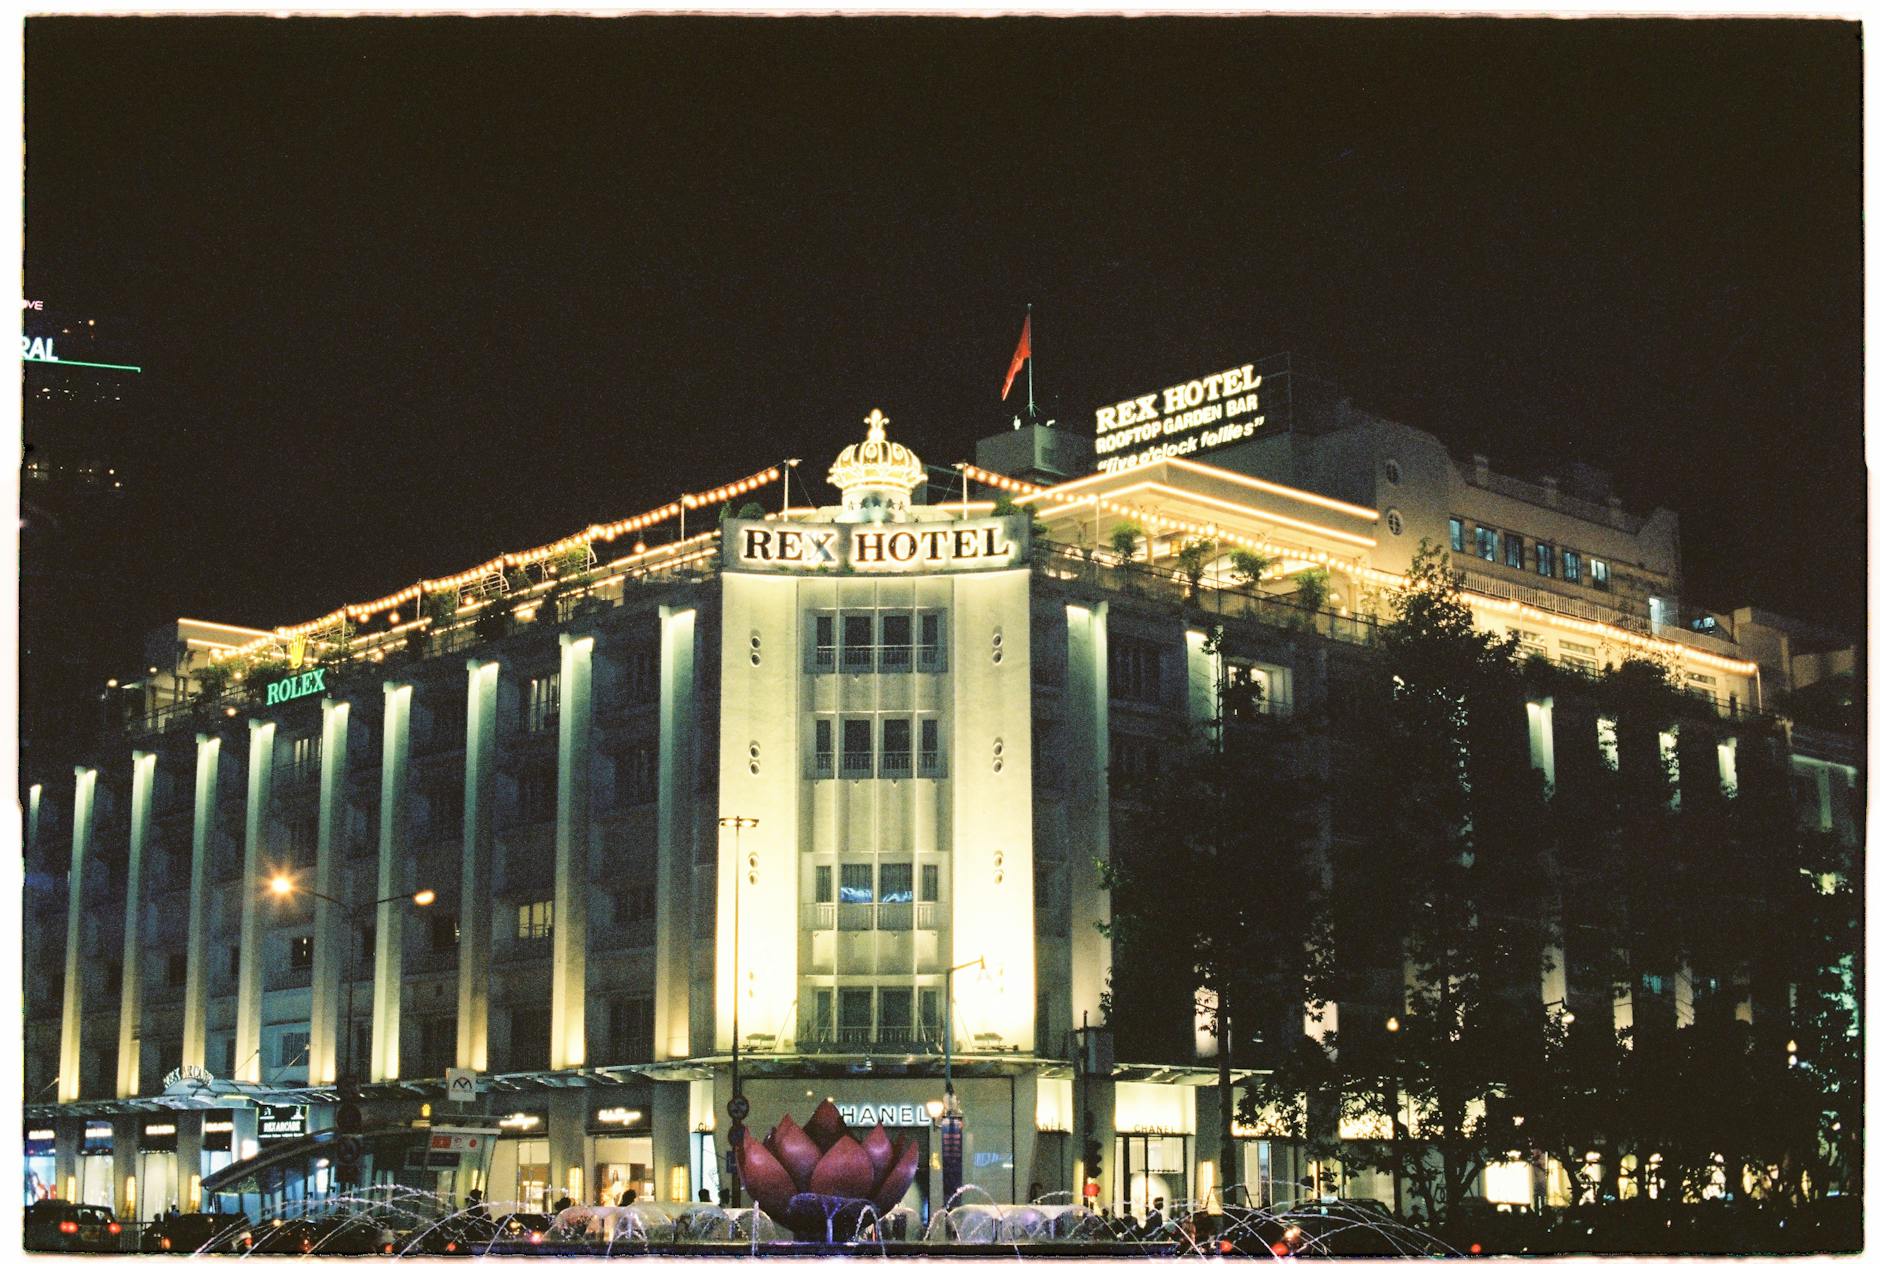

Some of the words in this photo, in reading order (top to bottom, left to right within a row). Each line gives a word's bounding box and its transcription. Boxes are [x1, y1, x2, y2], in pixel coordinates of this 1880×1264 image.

[1096, 394, 1159, 434] REX
[1163, 364, 1263, 415] HOTEL
[1095, 420, 1163, 454] ROOFTOP
[1163, 404, 1222, 435] GARDEN
[1226, 394, 1259, 418] BAR
[743, 529, 836, 562] REX
[854, 527, 1010, 562] HOTEL
[266, 668, 326, 706] ROLEX
[841, 1106, 931, 1124] HANEL
